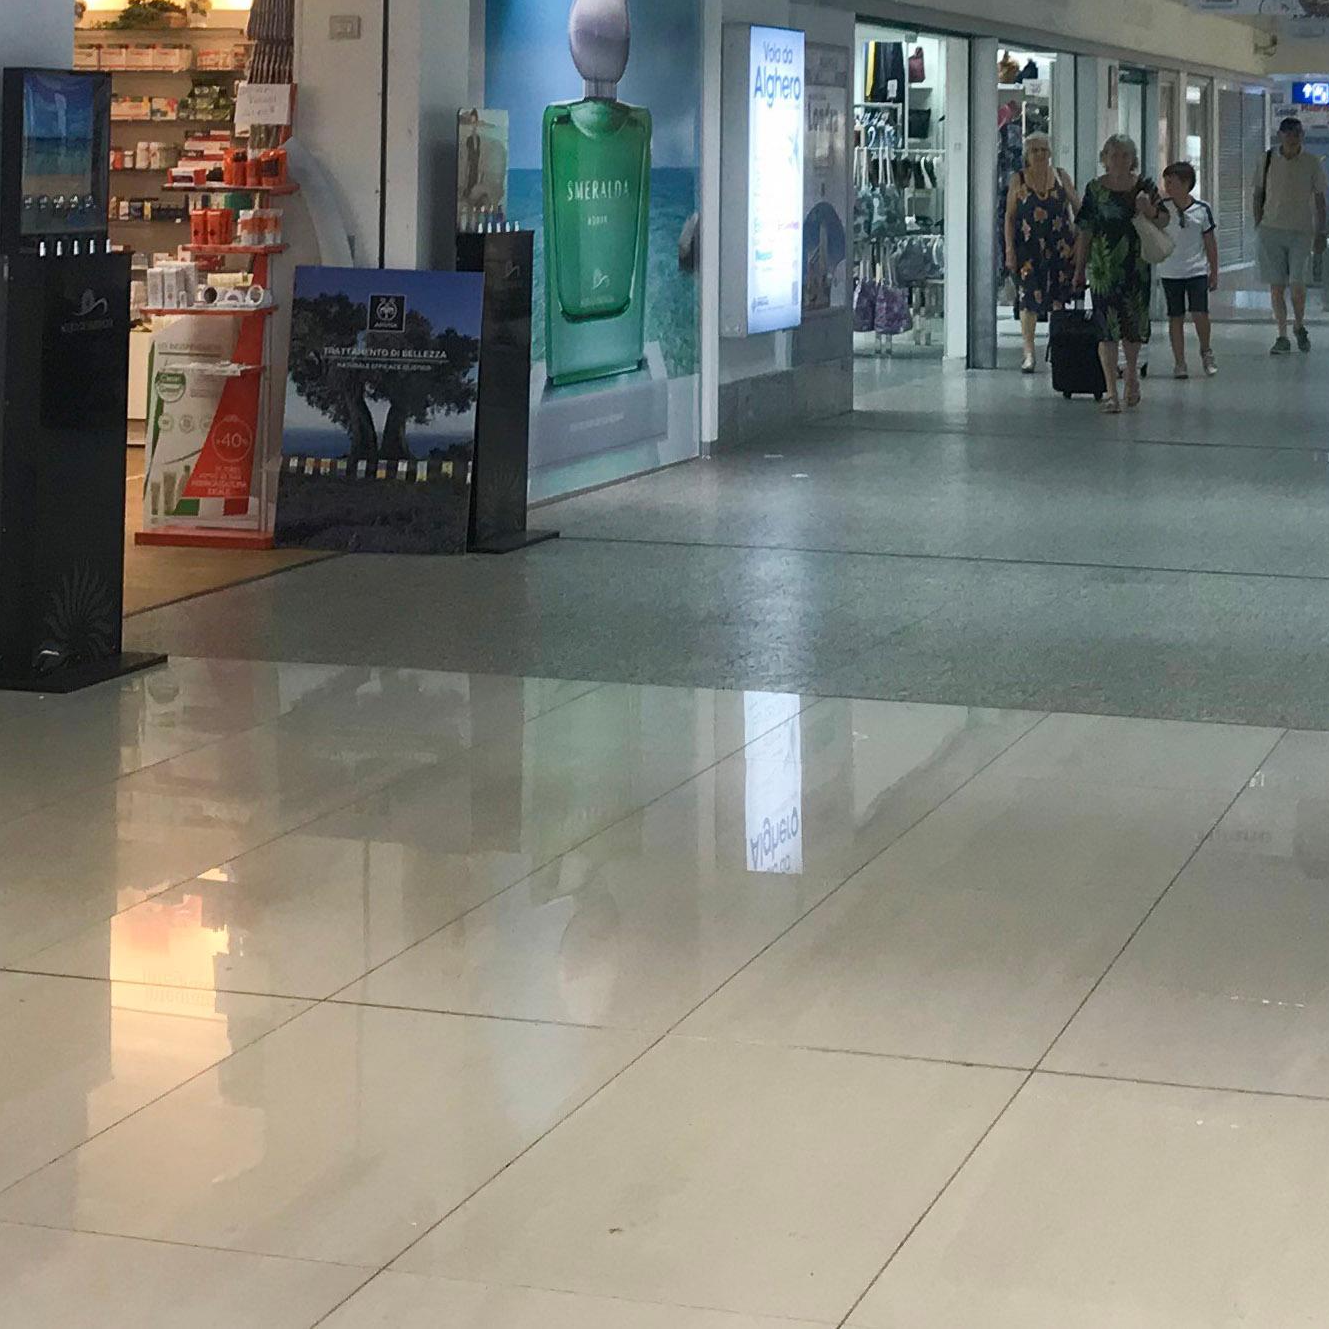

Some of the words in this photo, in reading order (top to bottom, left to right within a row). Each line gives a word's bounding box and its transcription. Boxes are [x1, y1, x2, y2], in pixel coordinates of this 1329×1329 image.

[763, 41, 781, 63] Volo
[782, 46, 793, 64] da
[754, 65, 801, 110] Alghero
[390, 349, 402, 358] DI
[402, 349, 448, 359] BELLEZZA
